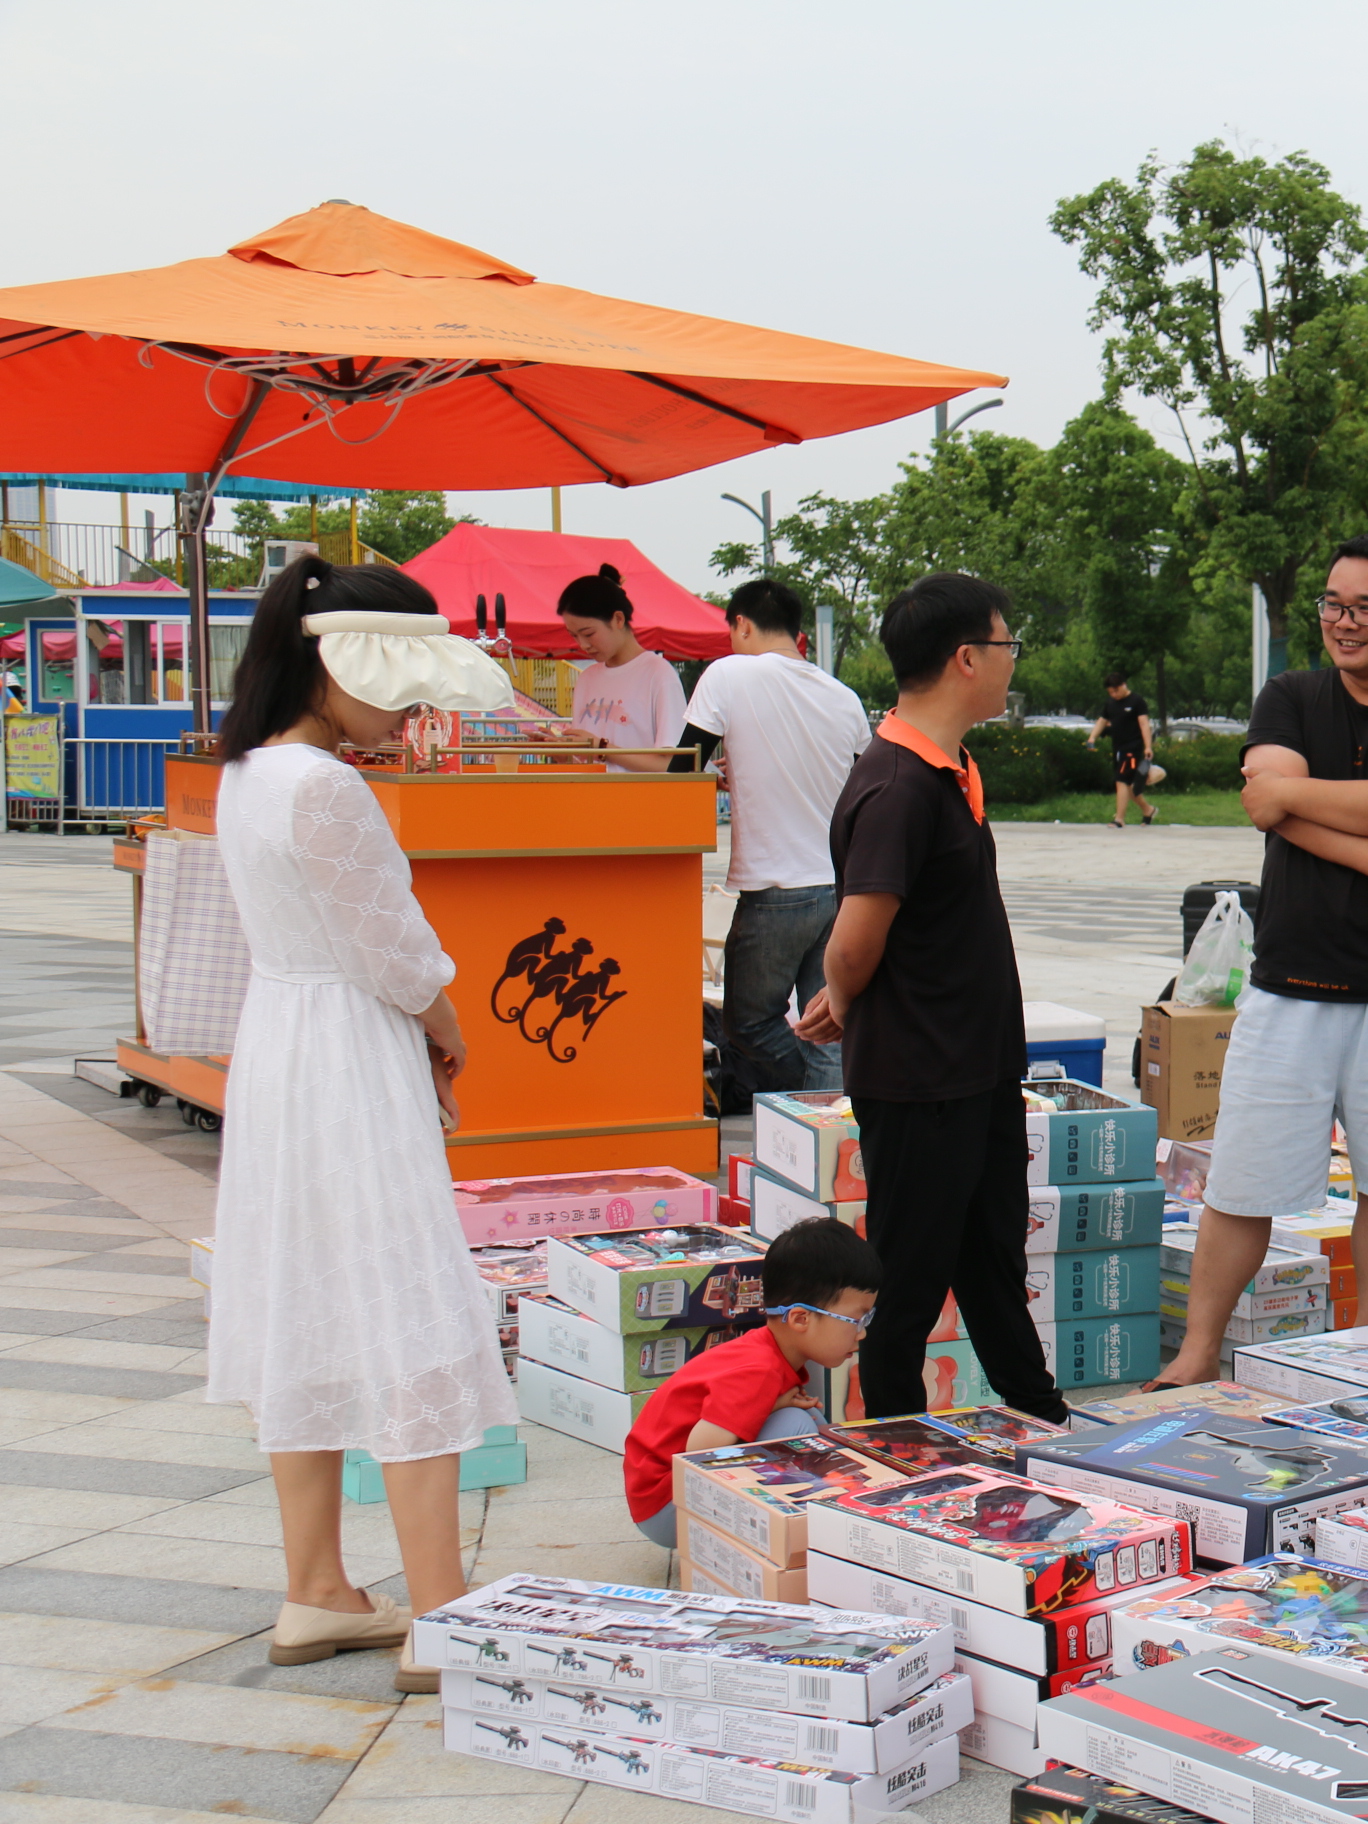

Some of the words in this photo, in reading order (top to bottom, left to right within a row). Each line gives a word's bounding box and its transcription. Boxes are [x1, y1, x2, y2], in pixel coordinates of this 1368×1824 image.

[1103, 1118, 1116, 1176] 快乐小诊所
[1111, 1186, 1126, 1241] 快乐小诊所
[1108, 1253, 1120, 1311] 快乐小诊所
[1109, 1322, 1121, 1380] 快乐小诊所
[589, 1585, 668, 1601] AWM
[785, 1658, 846, 1667] AWM
[916, 1666, 930, 1683] AWM
[887, 1762, 928, 1794] 炫酷突击
[1245, 1745, 1342, 1780] AK47
